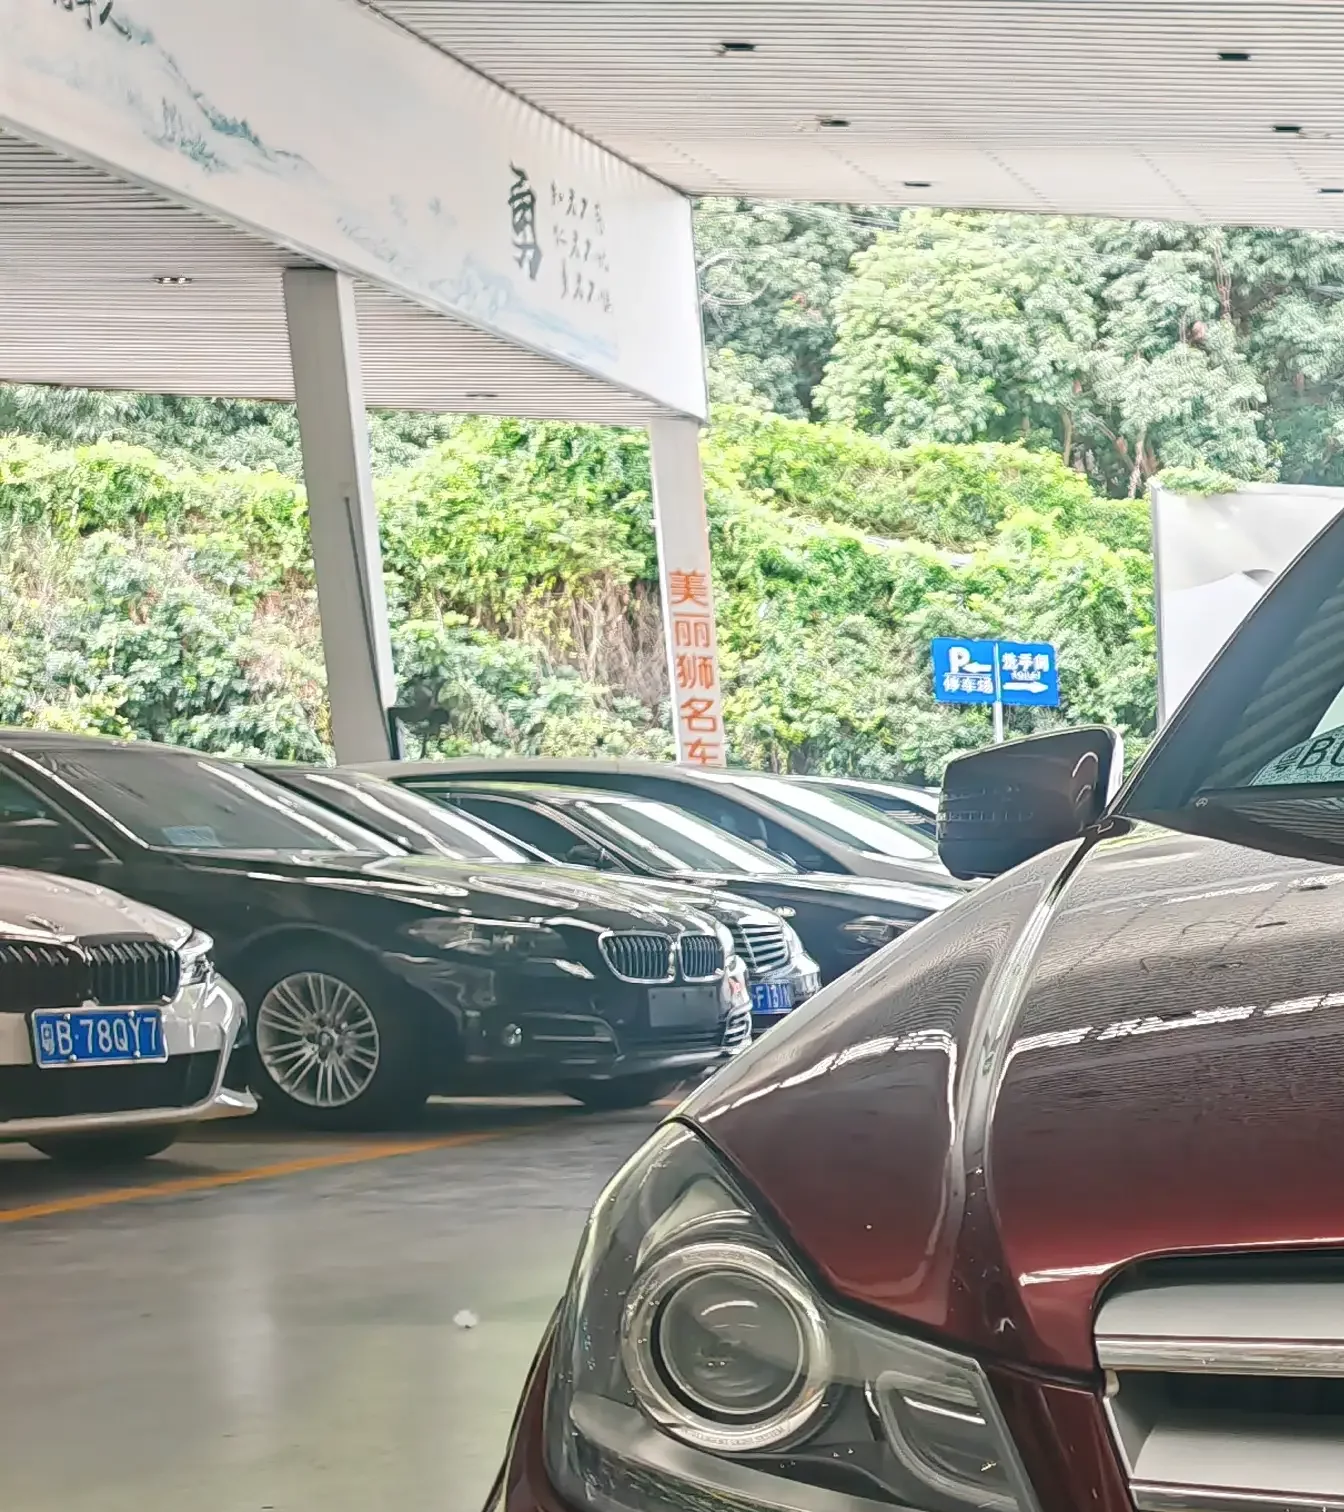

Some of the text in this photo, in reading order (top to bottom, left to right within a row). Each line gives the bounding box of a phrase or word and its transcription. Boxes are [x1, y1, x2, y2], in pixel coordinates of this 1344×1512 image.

[669, 567, 720, 764] 美丽狮名车
[948, 646, 971, 673] P
[943, 675, 994, 694] 停车场
